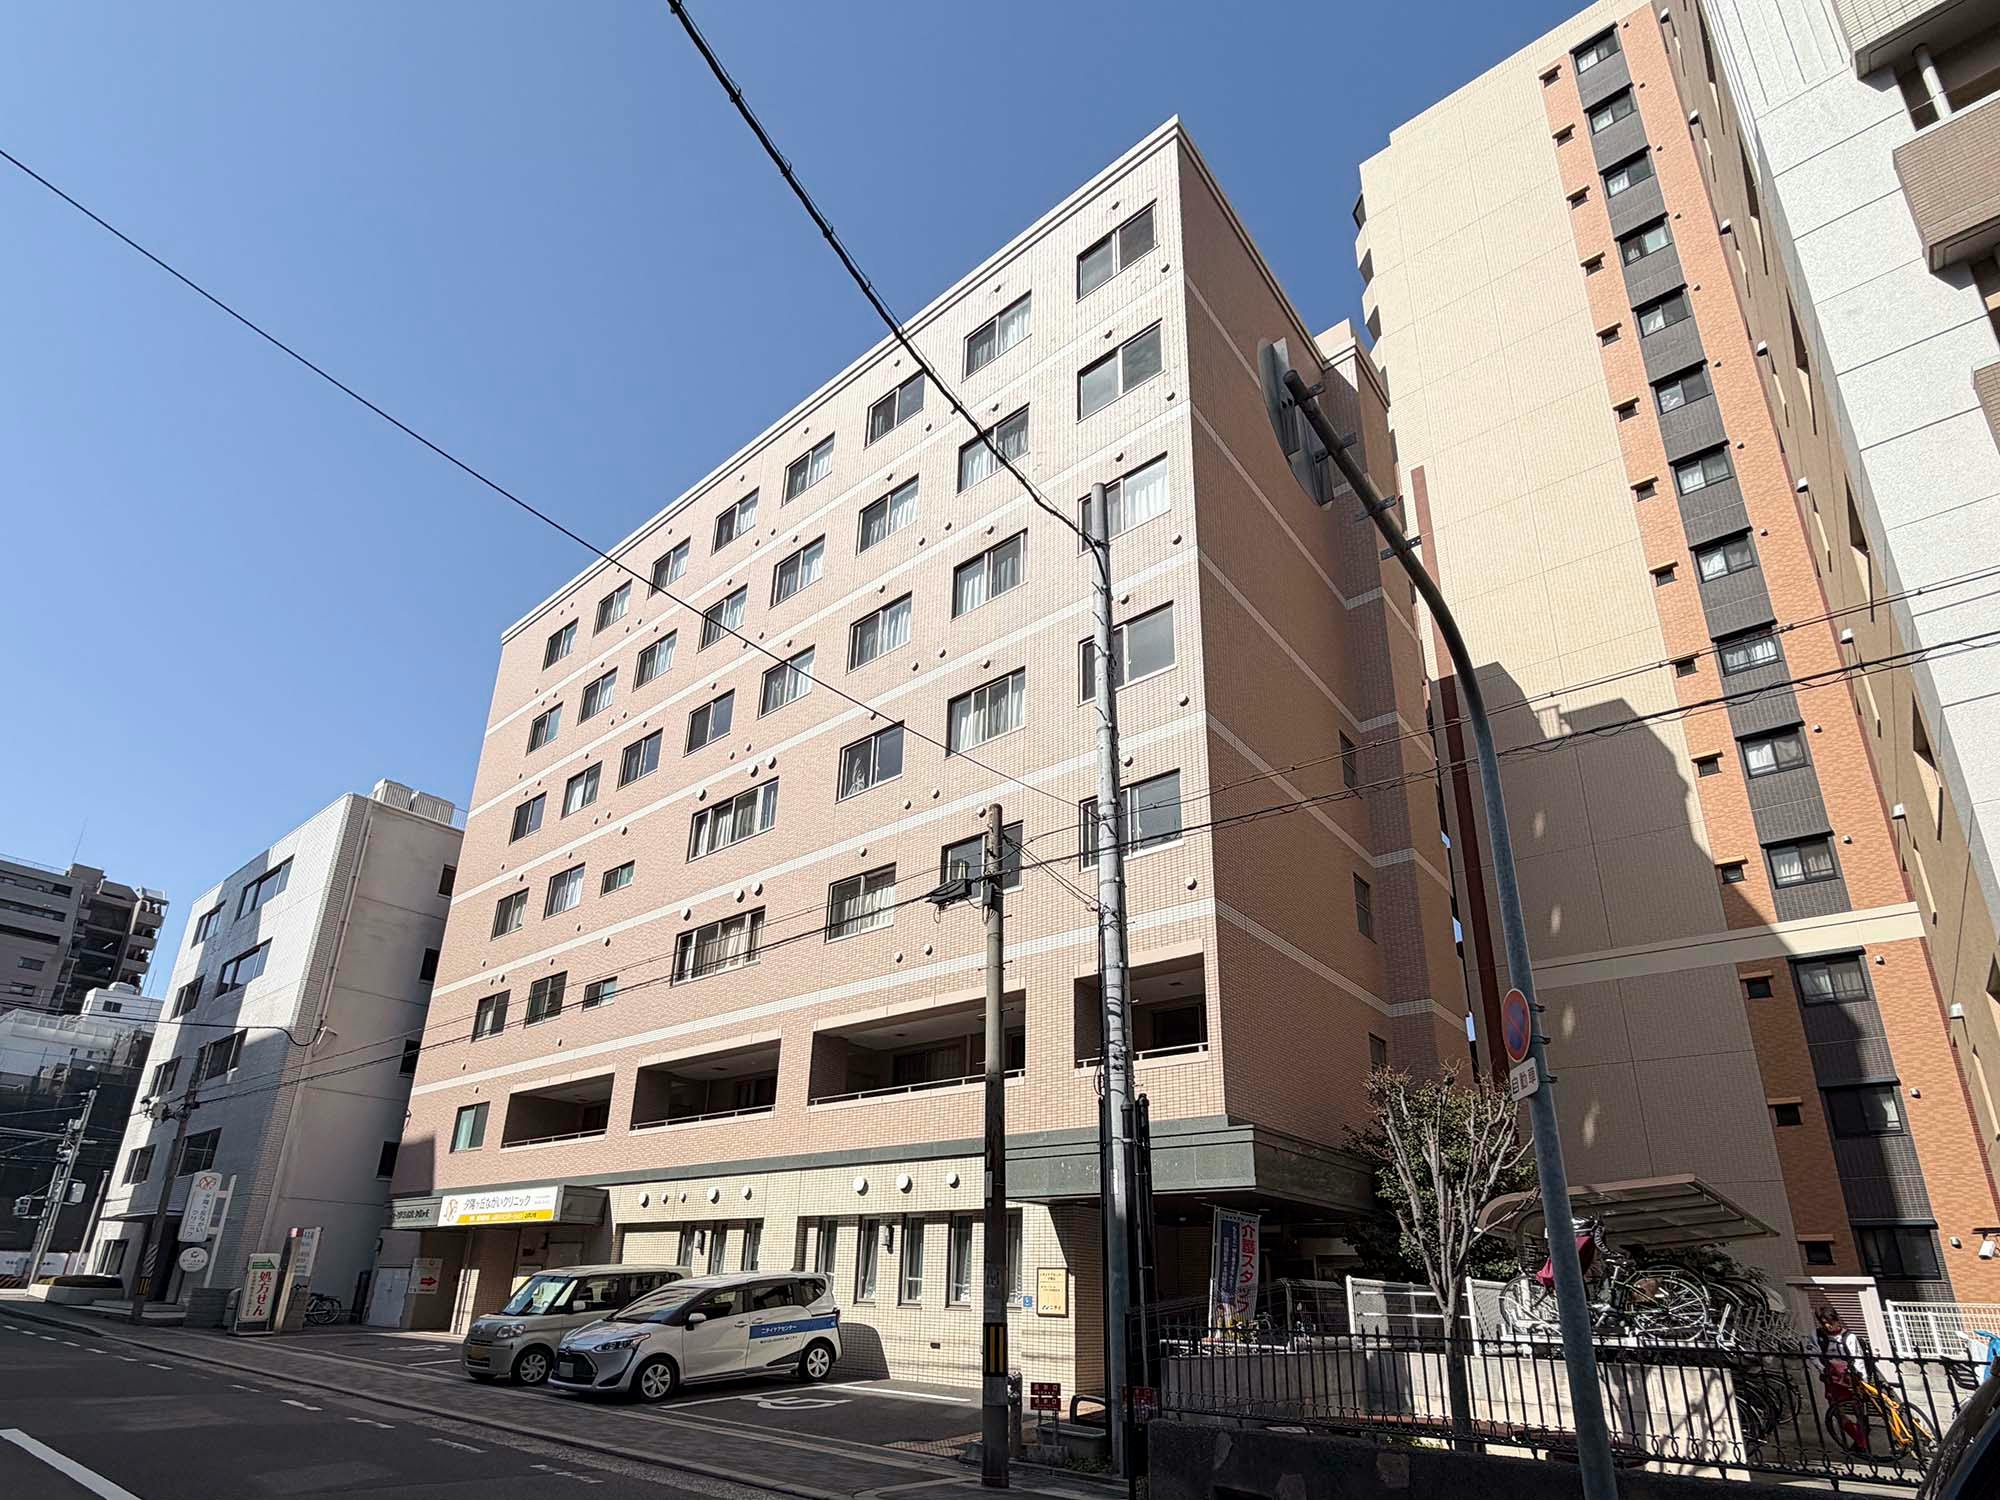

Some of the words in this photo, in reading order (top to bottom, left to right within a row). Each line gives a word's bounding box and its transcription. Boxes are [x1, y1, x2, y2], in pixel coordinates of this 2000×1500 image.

[1512, 1066, 1536, 1094] 自動車
[253, 1271, 273, 1317] 処方せん
